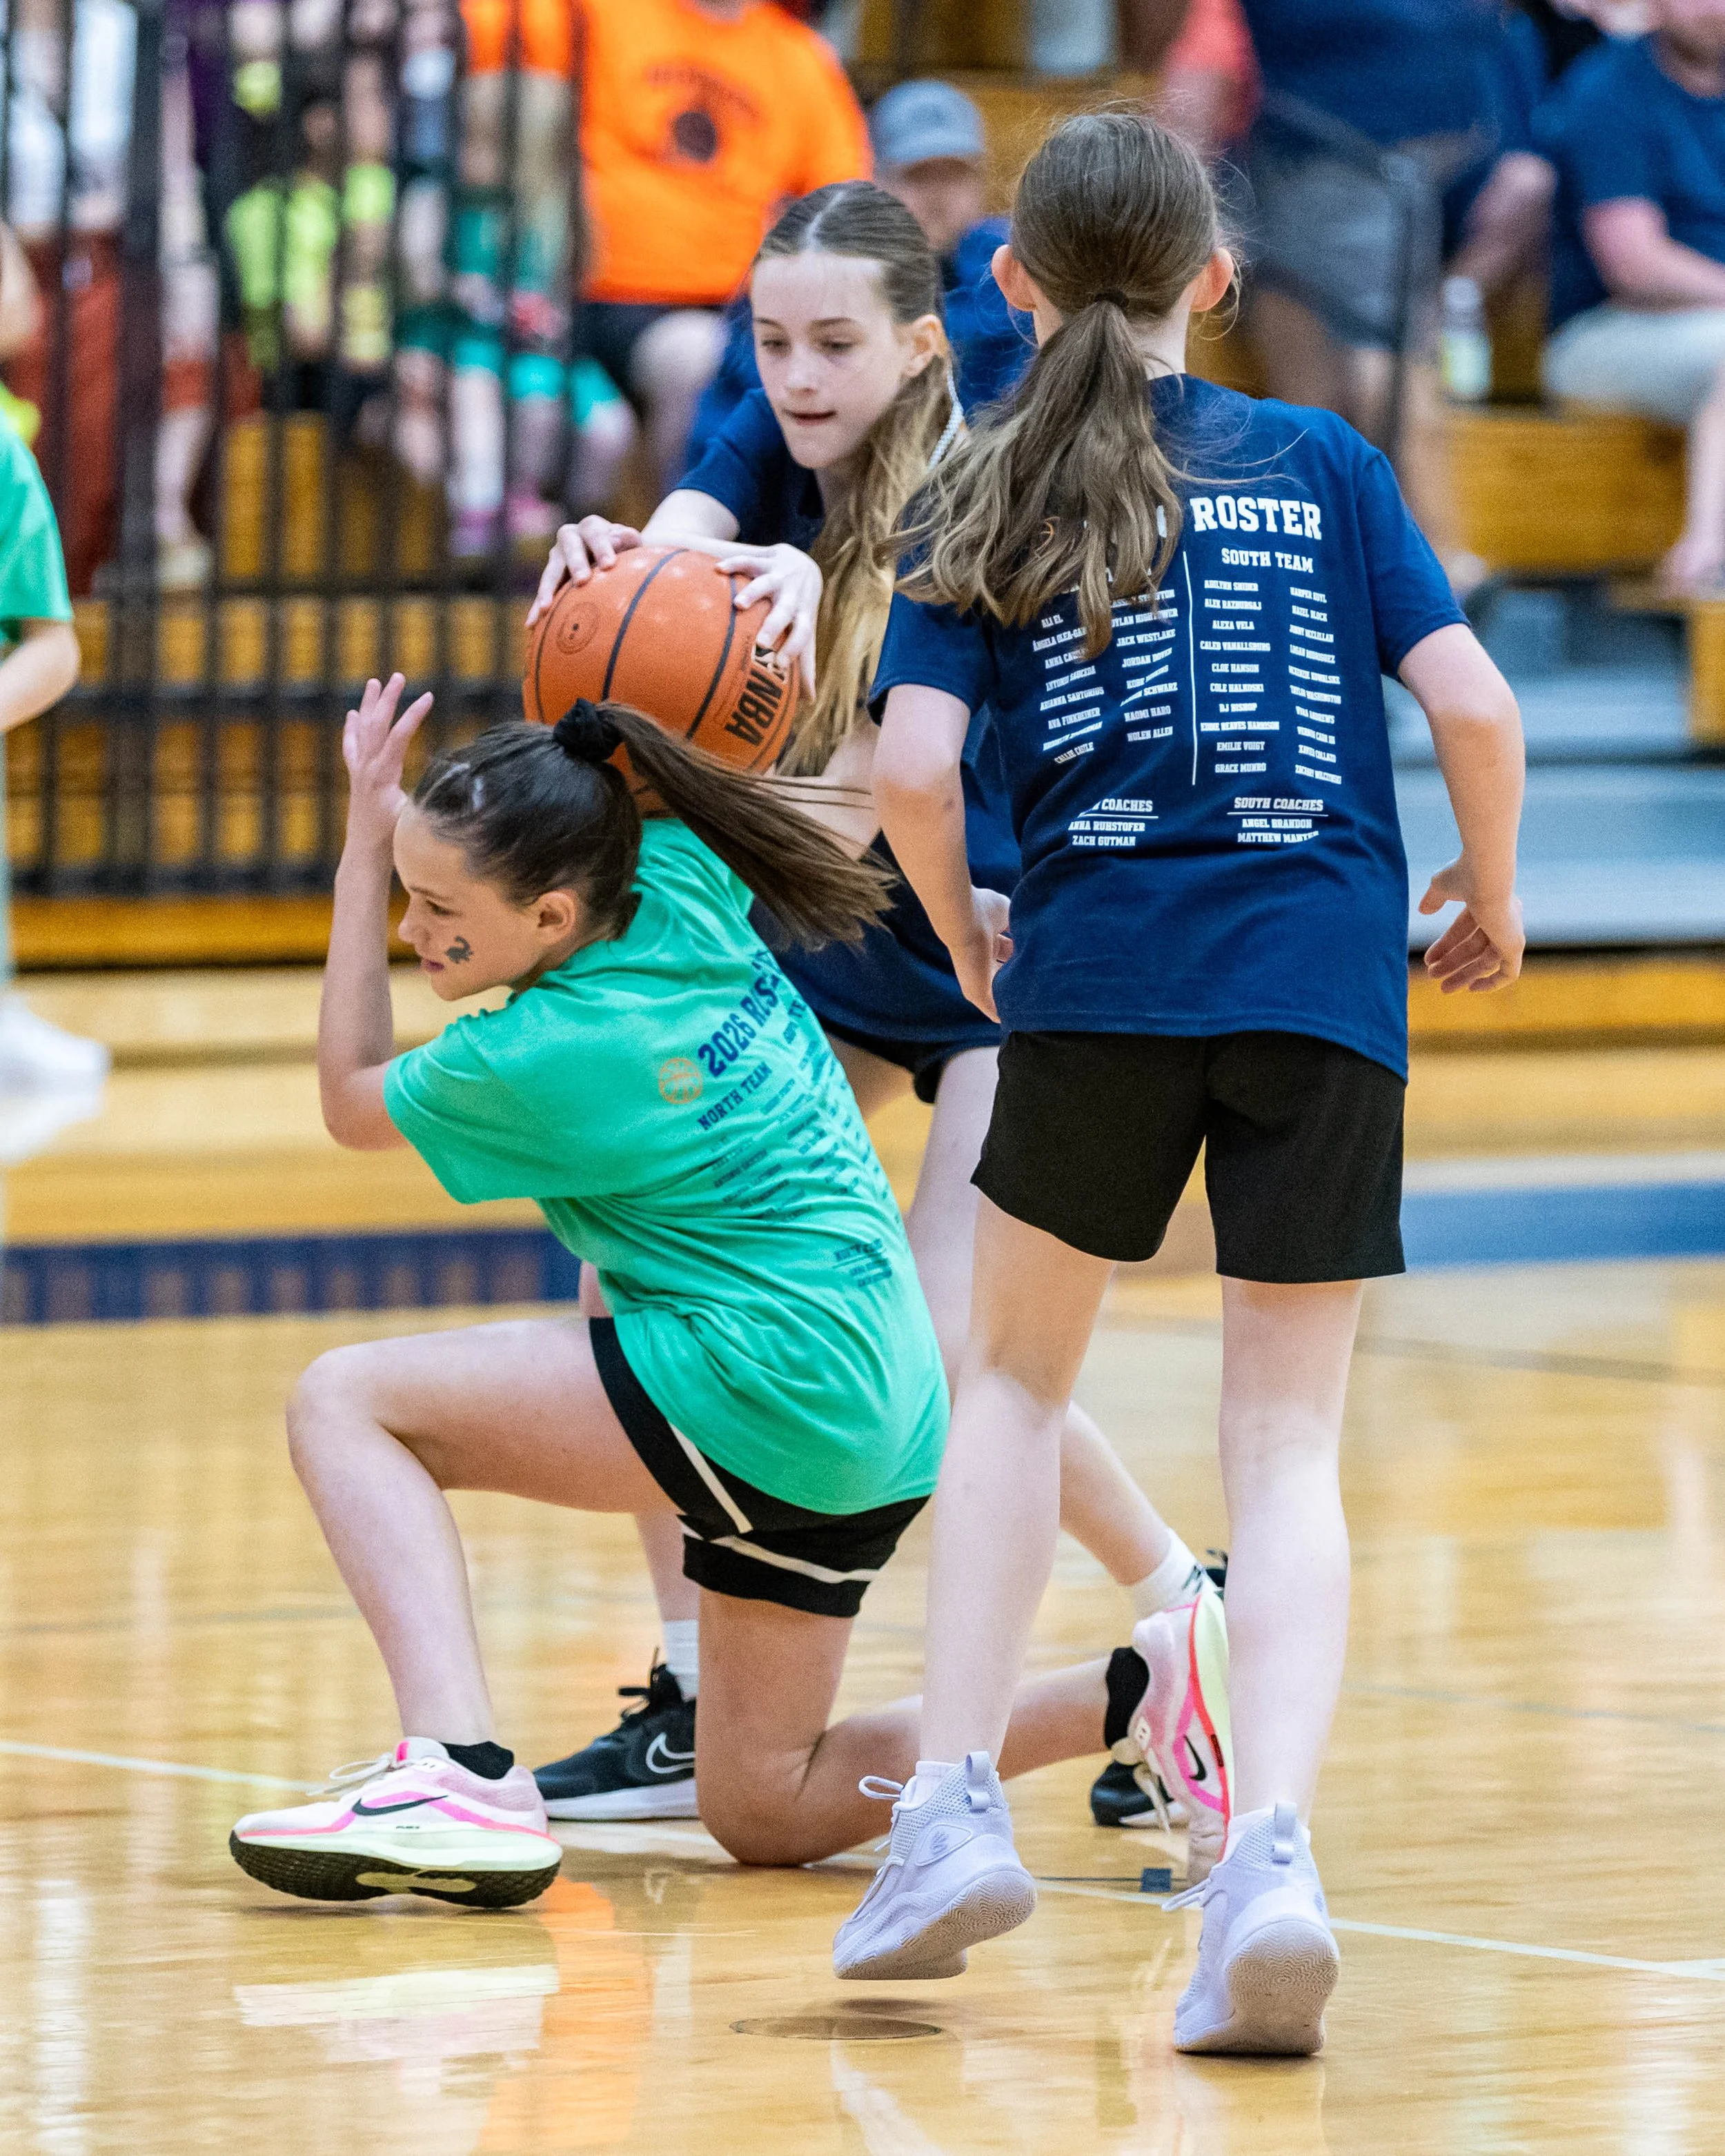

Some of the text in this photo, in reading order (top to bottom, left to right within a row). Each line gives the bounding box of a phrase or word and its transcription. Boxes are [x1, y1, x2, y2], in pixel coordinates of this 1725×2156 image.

[1190, 495, 1322, 540] ROSTER
[1221, 548, 1314, 574] SOUTH TEAM
[1212, 620, 1255, 631] ALEXA VELA
[1116, 629, 1176, 647] JACK WESTLAKE
[1045, 655, 1064, 669] ANNA
[1122, 655, 1152, 668] JORDAN
[1230, 663, 1260, 673] HANSON
[1143, 682, 1179, 696] SCHWARZ
[1210, 682, 1228, 693] COLE
[725, 668, 783, 747] NBA
[1047, 718, 1062, 730] AVA
[1216, 741, 1242, 751] EMILIE
[1214, 763, 1239, 773] GRACE
[1101, 798, 1153, 813] COACHES
[1234, 797, 1324, 812] SOUTH COACHES
[1068, 820, 1092, 831] ANNA
[1241, 818, 1312, 829] ANGEL BRANDON
[1072, 835, 1136, 847] ZACH GUTMAN
[1237, 832, 1281, 842] MATTHEW
[697, 1012, 756, 1078] 2026
[697, 1088, 744, 1131] NORTH
[740, 1060, 773, 1094] TEAM
